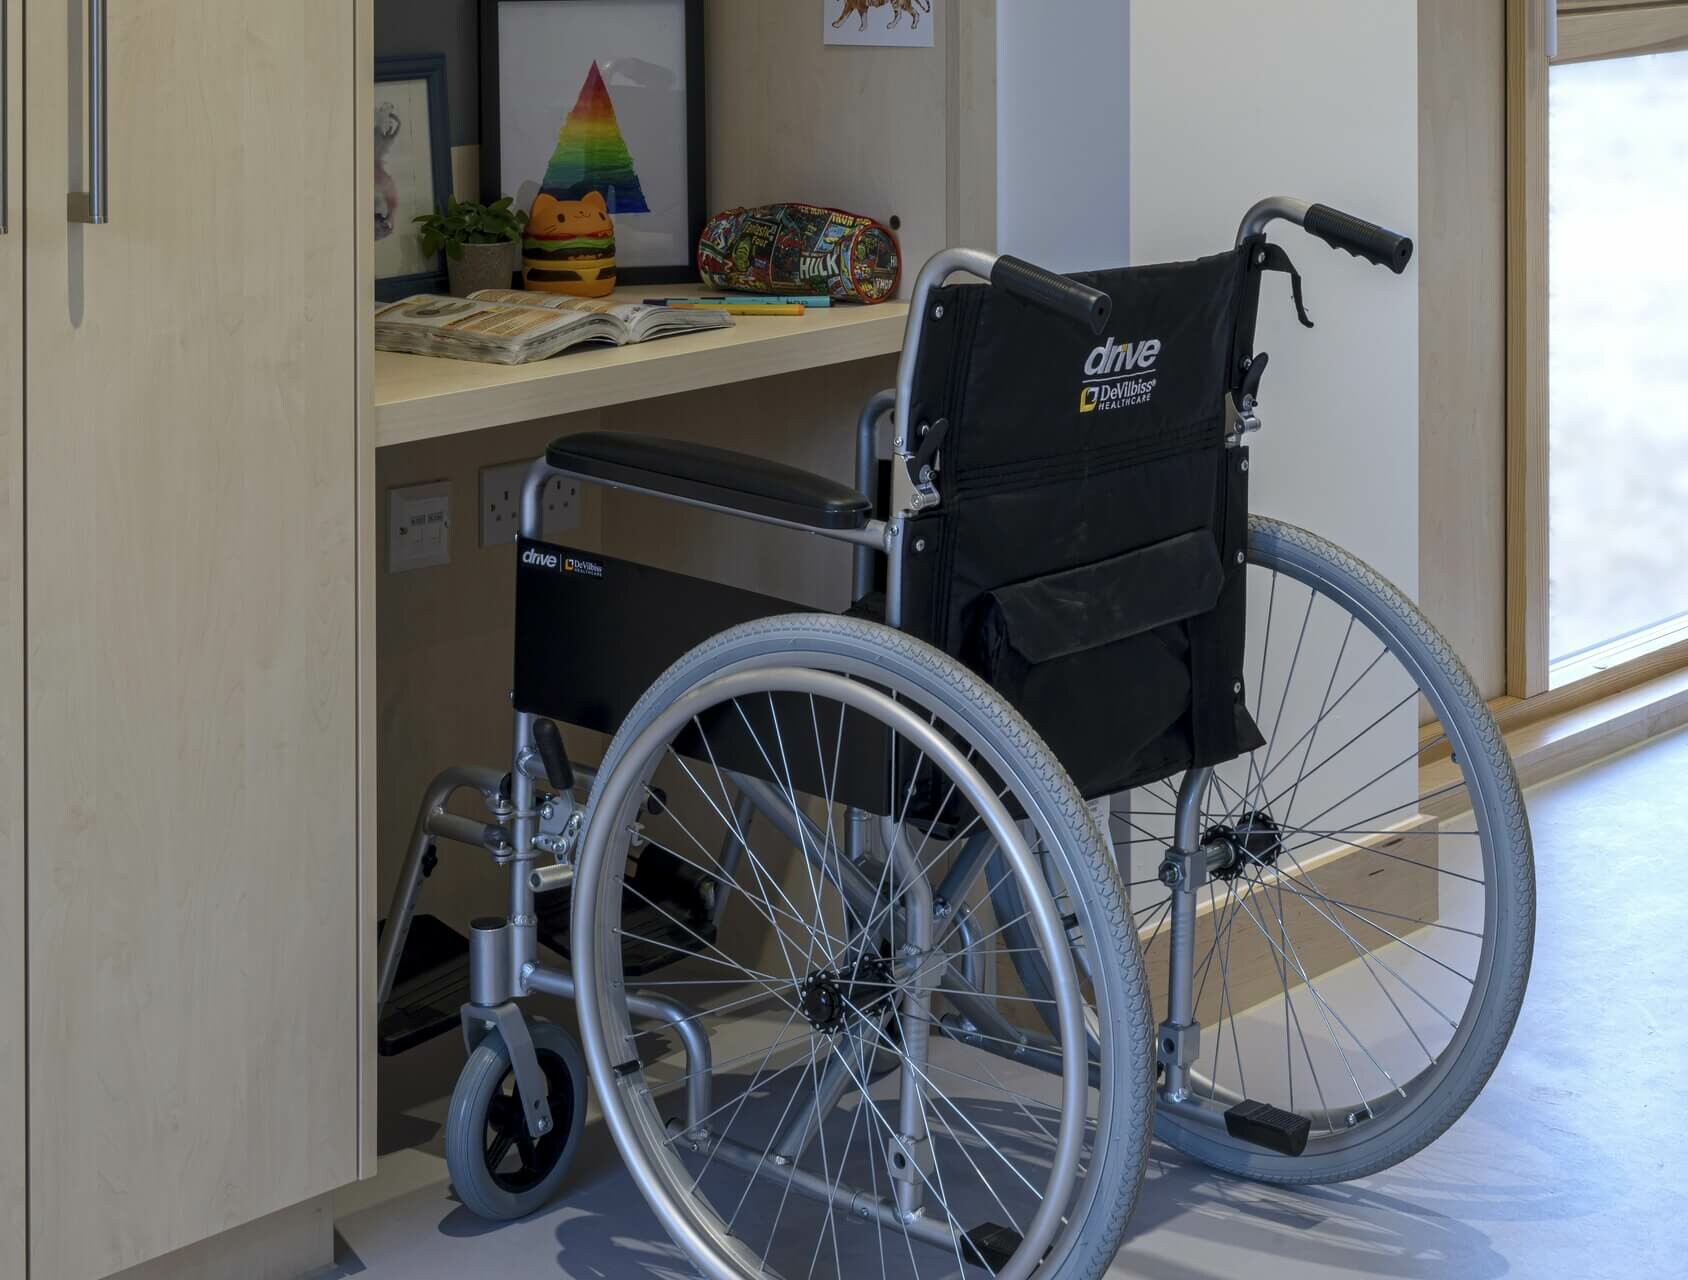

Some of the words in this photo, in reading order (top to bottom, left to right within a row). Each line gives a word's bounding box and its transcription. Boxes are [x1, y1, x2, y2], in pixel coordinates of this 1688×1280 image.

[799, 253, 840, 279] HULK
[1084, 336, 1161, 375] drive
[1101, 379, 1153, 401] DeVilbiss
[1098, 393, 1152, 410] HEALTHCARE
[522, 548, 557, 568] drive
